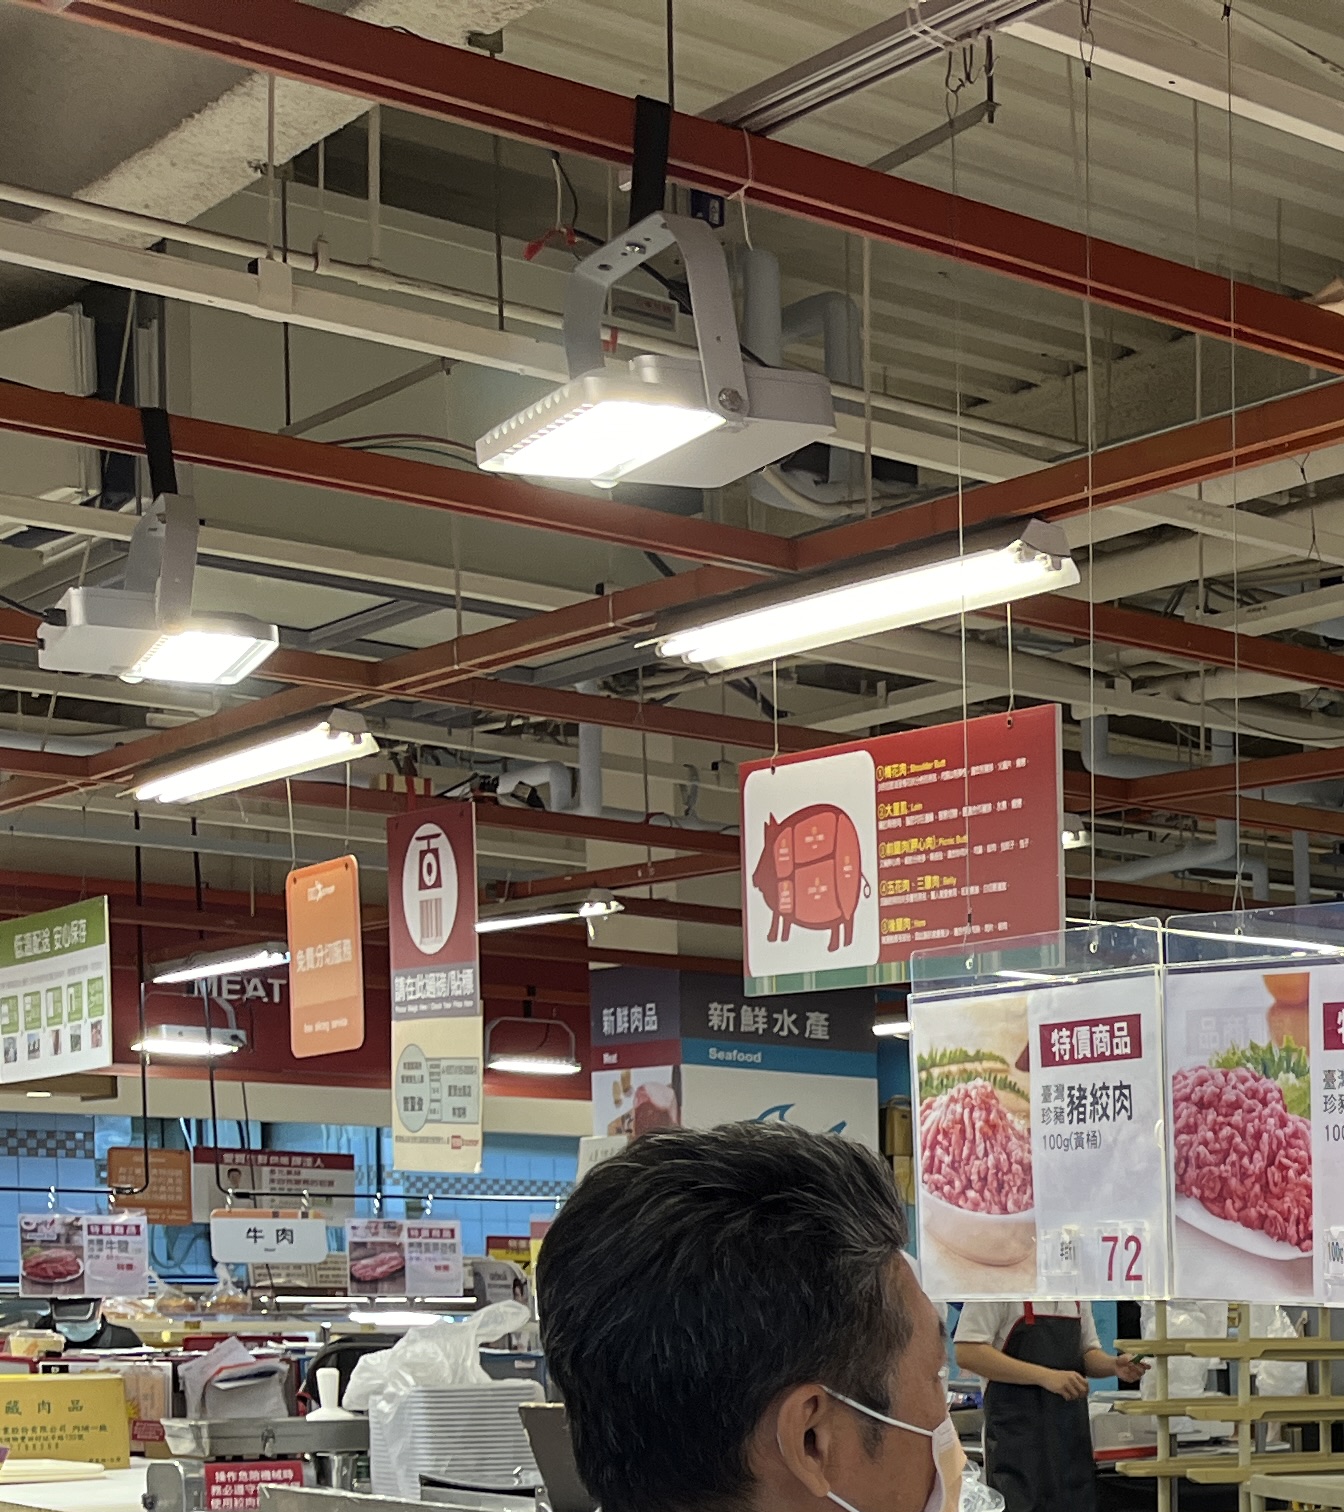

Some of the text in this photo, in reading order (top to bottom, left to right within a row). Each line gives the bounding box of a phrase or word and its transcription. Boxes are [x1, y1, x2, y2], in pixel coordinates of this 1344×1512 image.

[602, 1003, 658, 1036] 新鮮肉品
[707, 1002, 830, 1040] 新鮮水產
[708, 1048, 762, 1063] Seafood
[1051, 1021, 1132, 1062] 特價商品
[1041, 1084, 1065, 1104] 臺灣
[1066, 1080, 1133, 1126] 豬絞肉
[1041, 1106, 1065, 1125] 珍豬
[1043, 1129, 1102, 1152] 100g(黃桶)
[245, 1227, 295, 1245] 牛肉
[1101, 1234, 1143, 1282] 72
